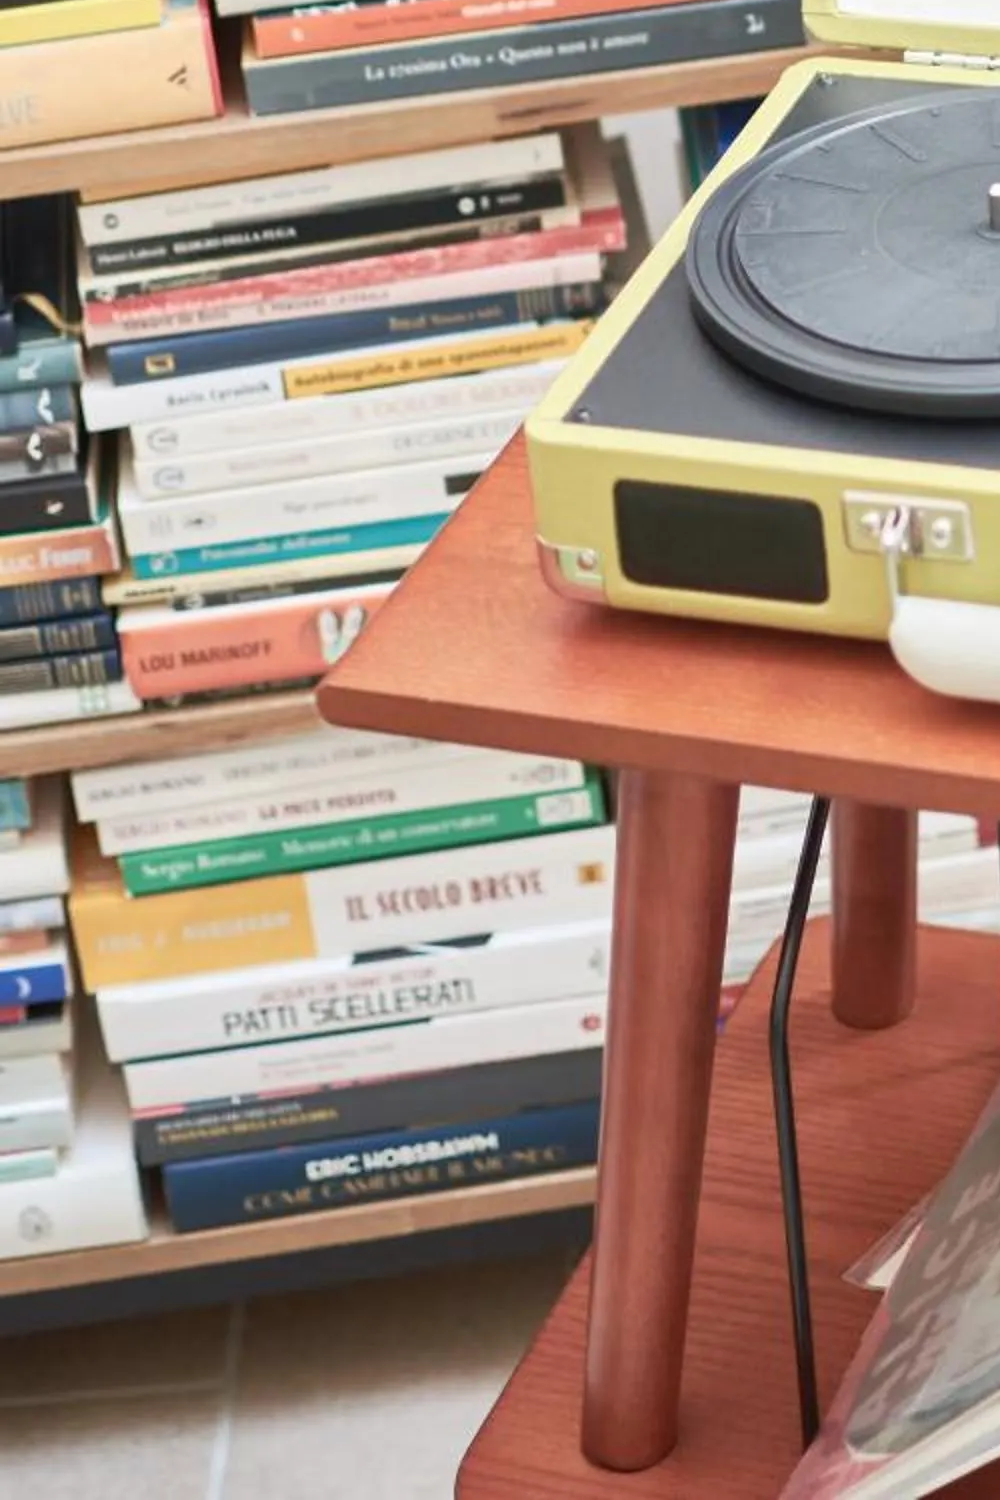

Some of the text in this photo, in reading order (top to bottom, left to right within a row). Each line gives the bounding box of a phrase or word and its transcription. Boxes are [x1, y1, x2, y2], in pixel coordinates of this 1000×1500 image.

[364, 64, 384, 82] La
[450, 52, 482, 71] Ora
[498, 43, 555, 66] Questo
[557, 39, 587, 56] non
[603, 31, 650, 50] amore
[293, 359, 396, 388] Autobiografia
[399, 355, 414, 371] di
[416, 353, 445, 369] uno
[138, 638, 274, 674] LOU MARINOFF
[258, 803, 279, 821] LA
[140, 860, 195, 881] Sergio
[344, 869, 545, 922] IL SECOLO BREVE
[221, 1004, 299, 1037] PATTI
[308, 977, 477, 1026] SCELLERATI
[304, 1153, 362, 1181] ERIC
